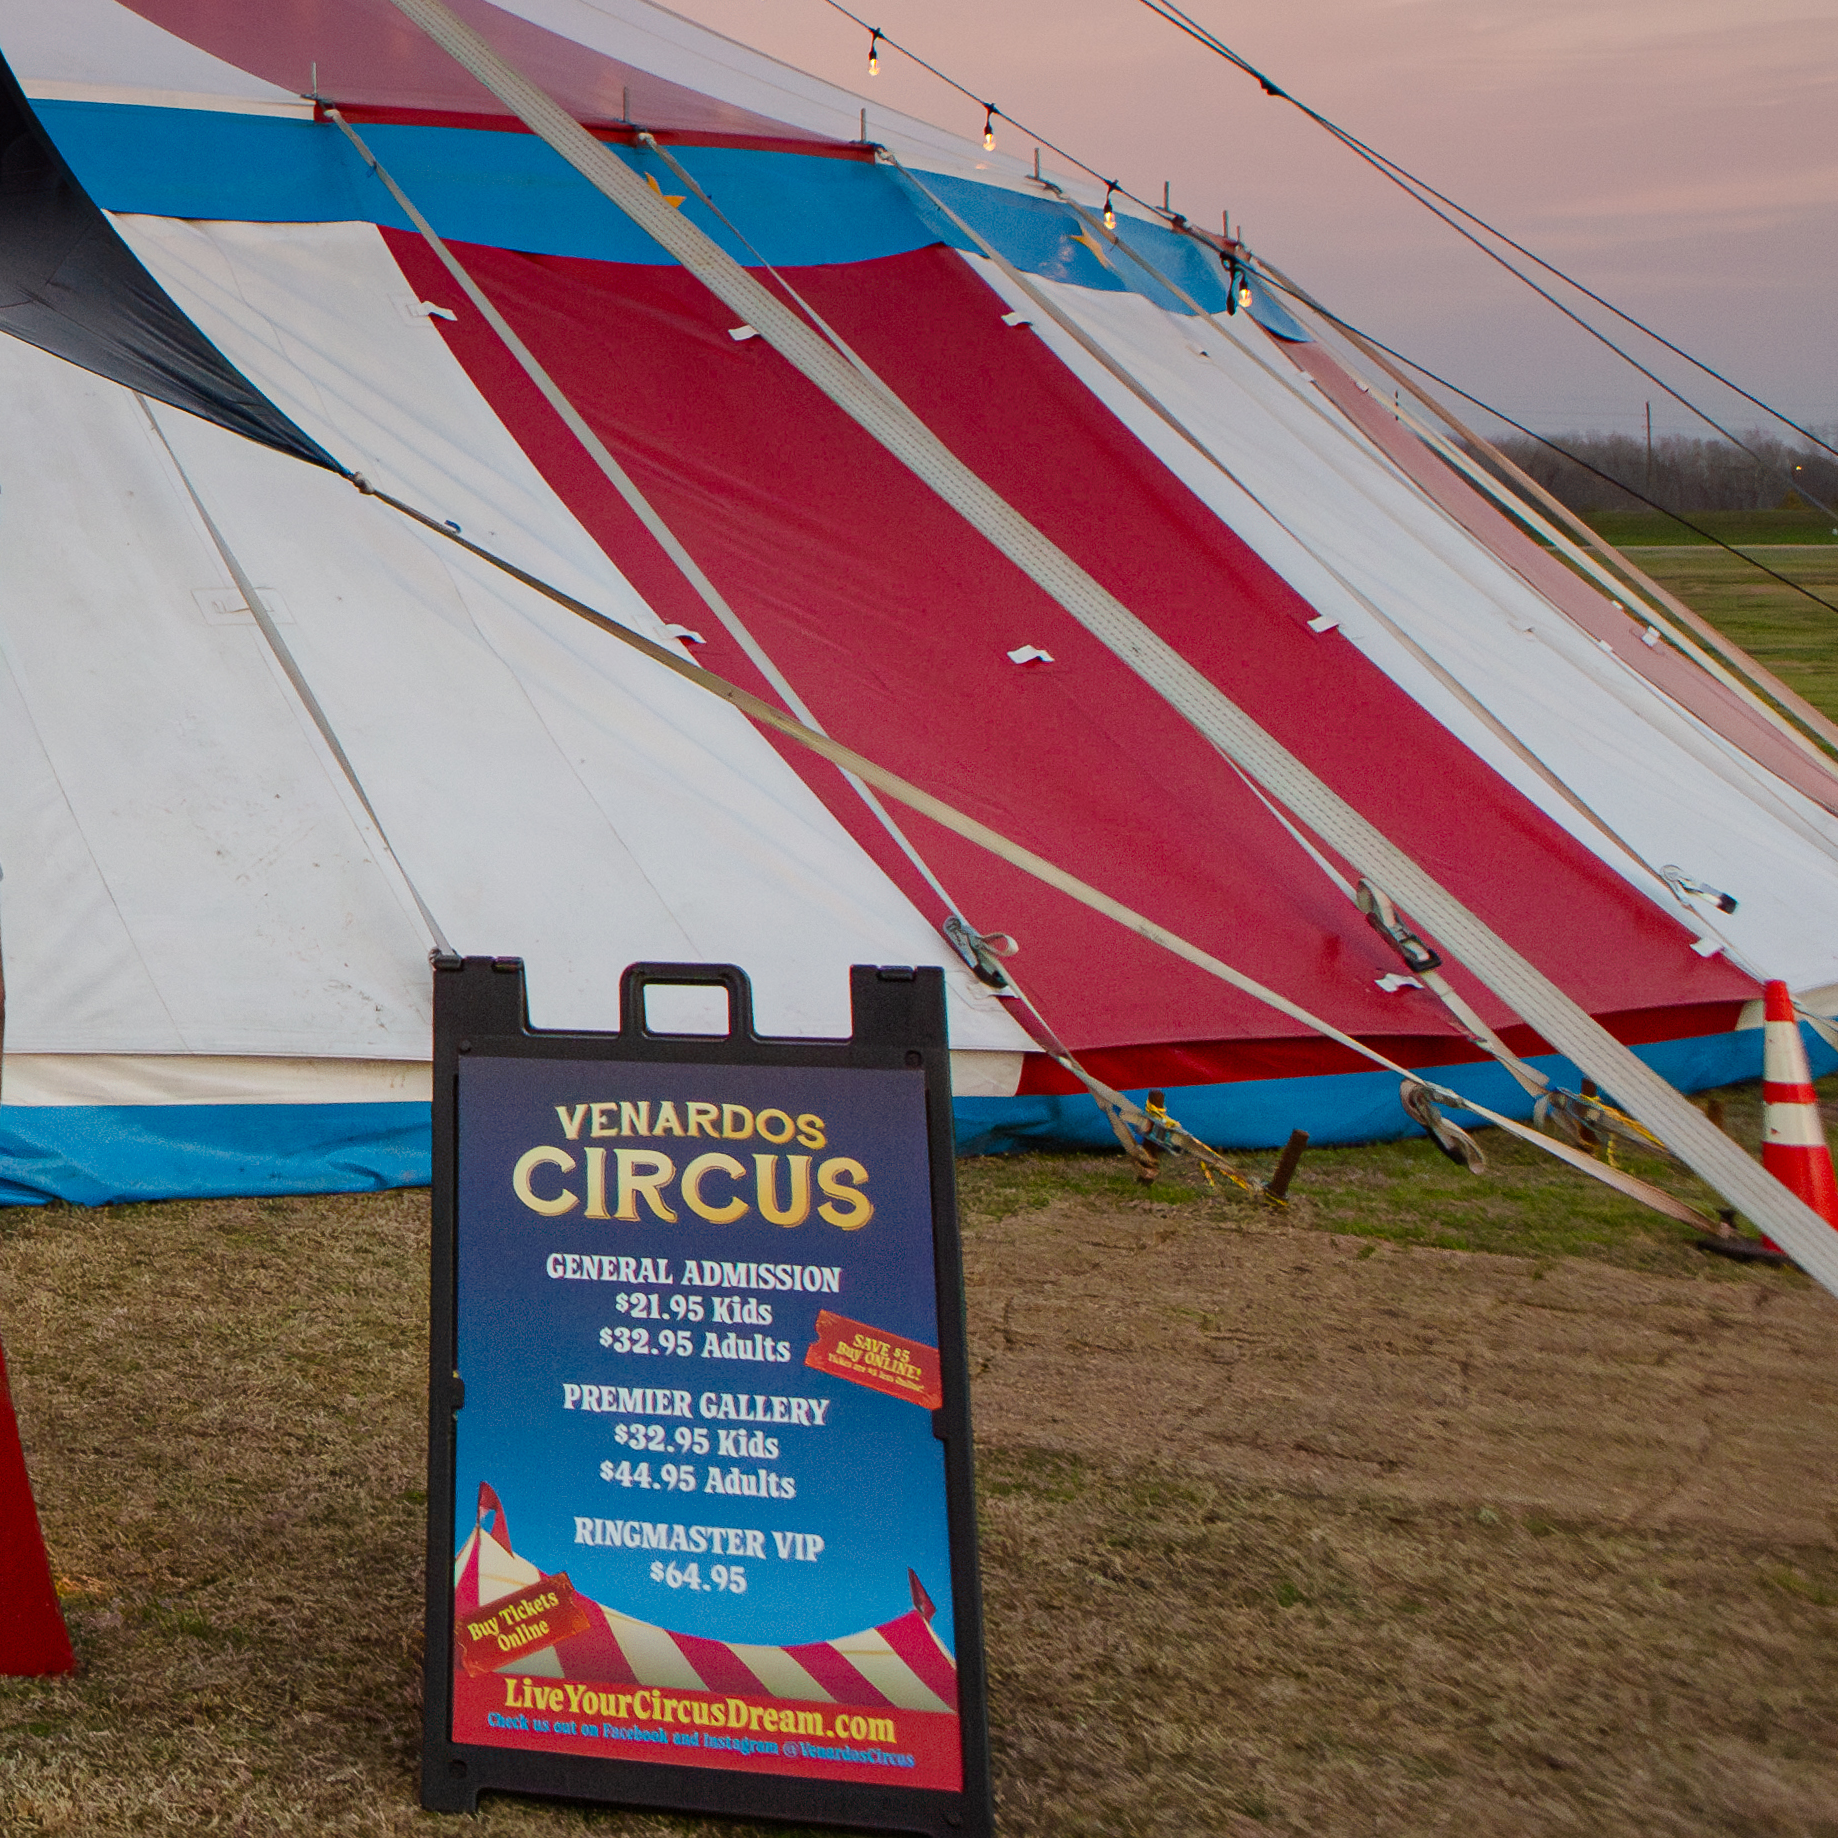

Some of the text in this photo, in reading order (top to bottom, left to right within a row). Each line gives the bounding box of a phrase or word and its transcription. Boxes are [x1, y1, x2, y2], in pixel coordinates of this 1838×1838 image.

[555, 1100, 826, 1150] VENARDOS
[513, 1145, 875, 1231] CIRCUS
[546, 1253, 841, 1293] GENERAL ADMISSION
[615, 1292, 773, 1325] $21.95 Kids
[599, 1326, 792, 1362] $32.95 Adults
[836, 1341, 863, 1362] Buy
[864, 1351, 922, 1381] ONLINE!
[853, 1333, 911, 1363] SAVE $5
[562, 1383, 830, 1426] PREMIER GALLERY
[614, 1423, 779, 1459] $32.95 Kids
[599, 1460, 797, 1499] $44.95 Adults
[574, 1516, 824, 1561] RINGMASTER VIP
[650, 1560, 747, 1594] $64.95
[467, 1592, 560, 1641] Buy Tickets
[497, 1620, 550, 1651] Online
[504, 1678, 897, 1744] LiveYourCircusDream.com
[488, 1712, 916, 1768] Check us out on Facebook and Instagram @VenardosCircus
